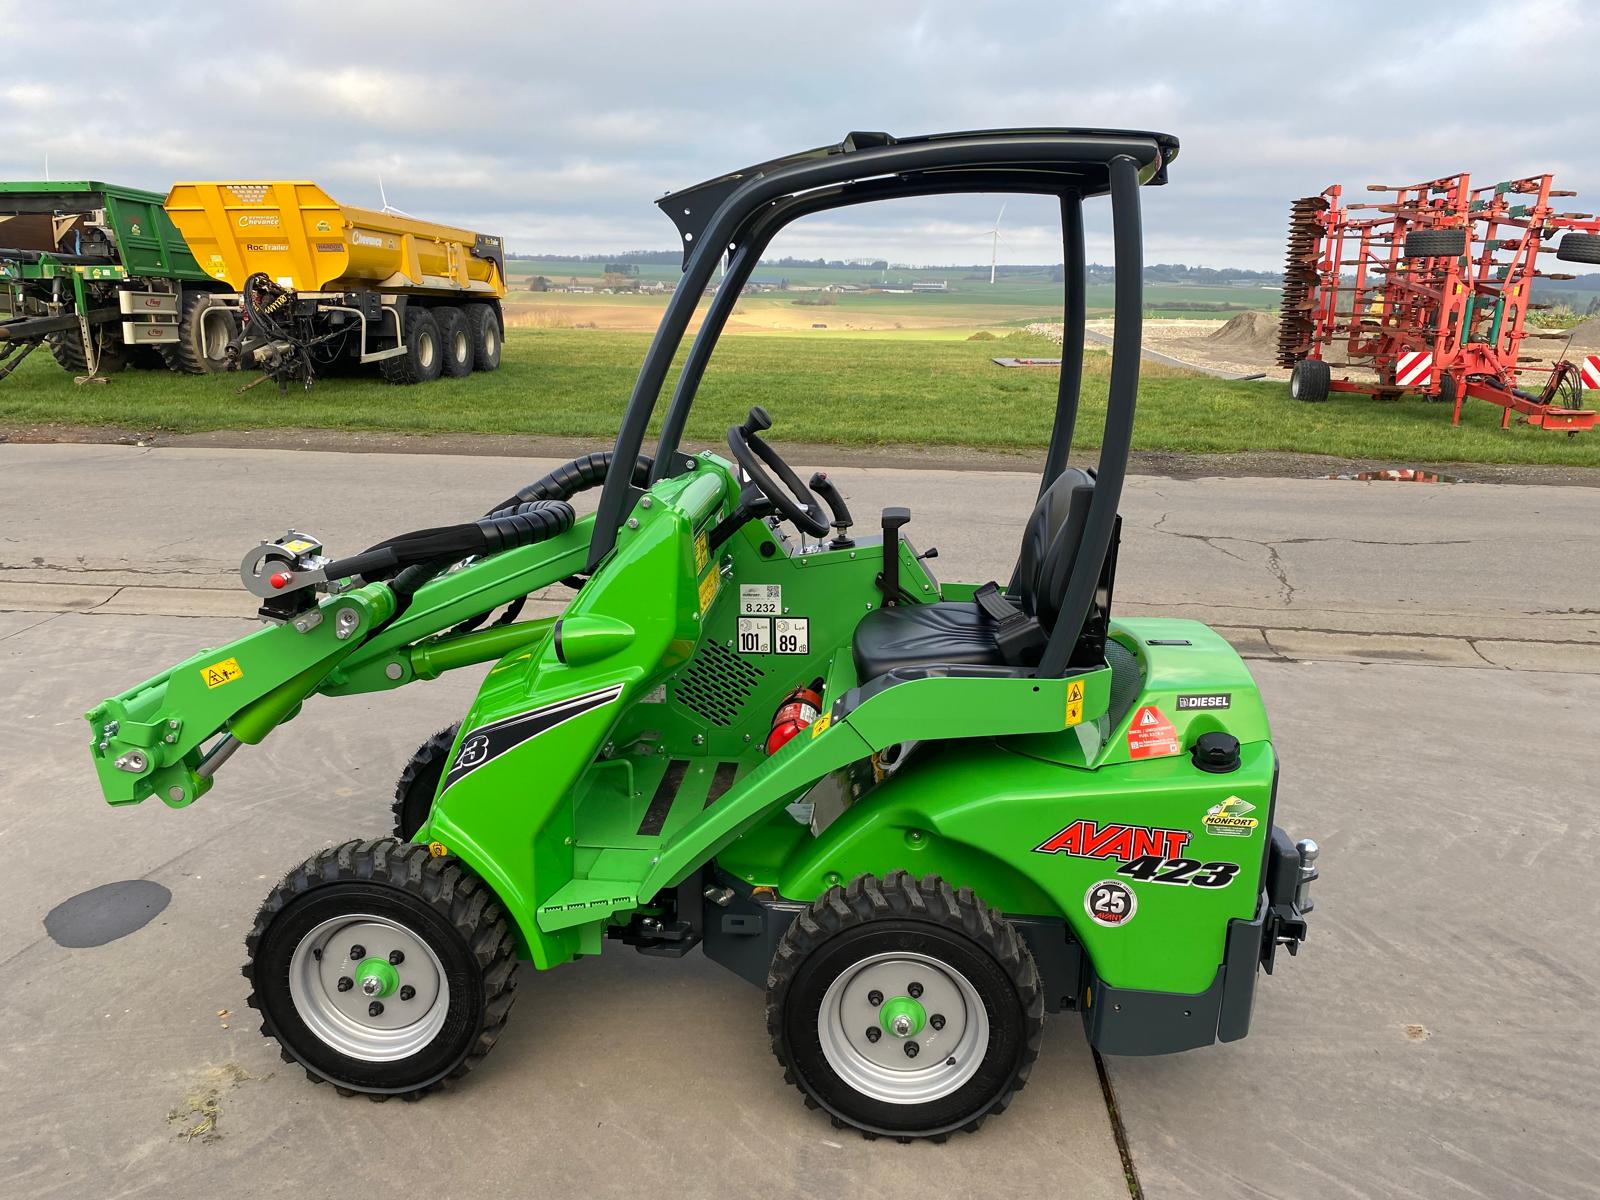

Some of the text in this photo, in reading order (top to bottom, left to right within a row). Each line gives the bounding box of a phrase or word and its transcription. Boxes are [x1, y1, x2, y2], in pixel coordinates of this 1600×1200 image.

[745, 603, 776, 613] 8.232
[740, 632, 759, 651] 101
[779, 634, 797, 652] 89
[1188, 696, 1229, 707] DIESEL
[1205, 817, 1254, 827] MONFORT
[1115, 855, 1240, 888] 423
[1095, 888, 1125, 914] 25
[1094, 911, 1123, 921] AVANT
